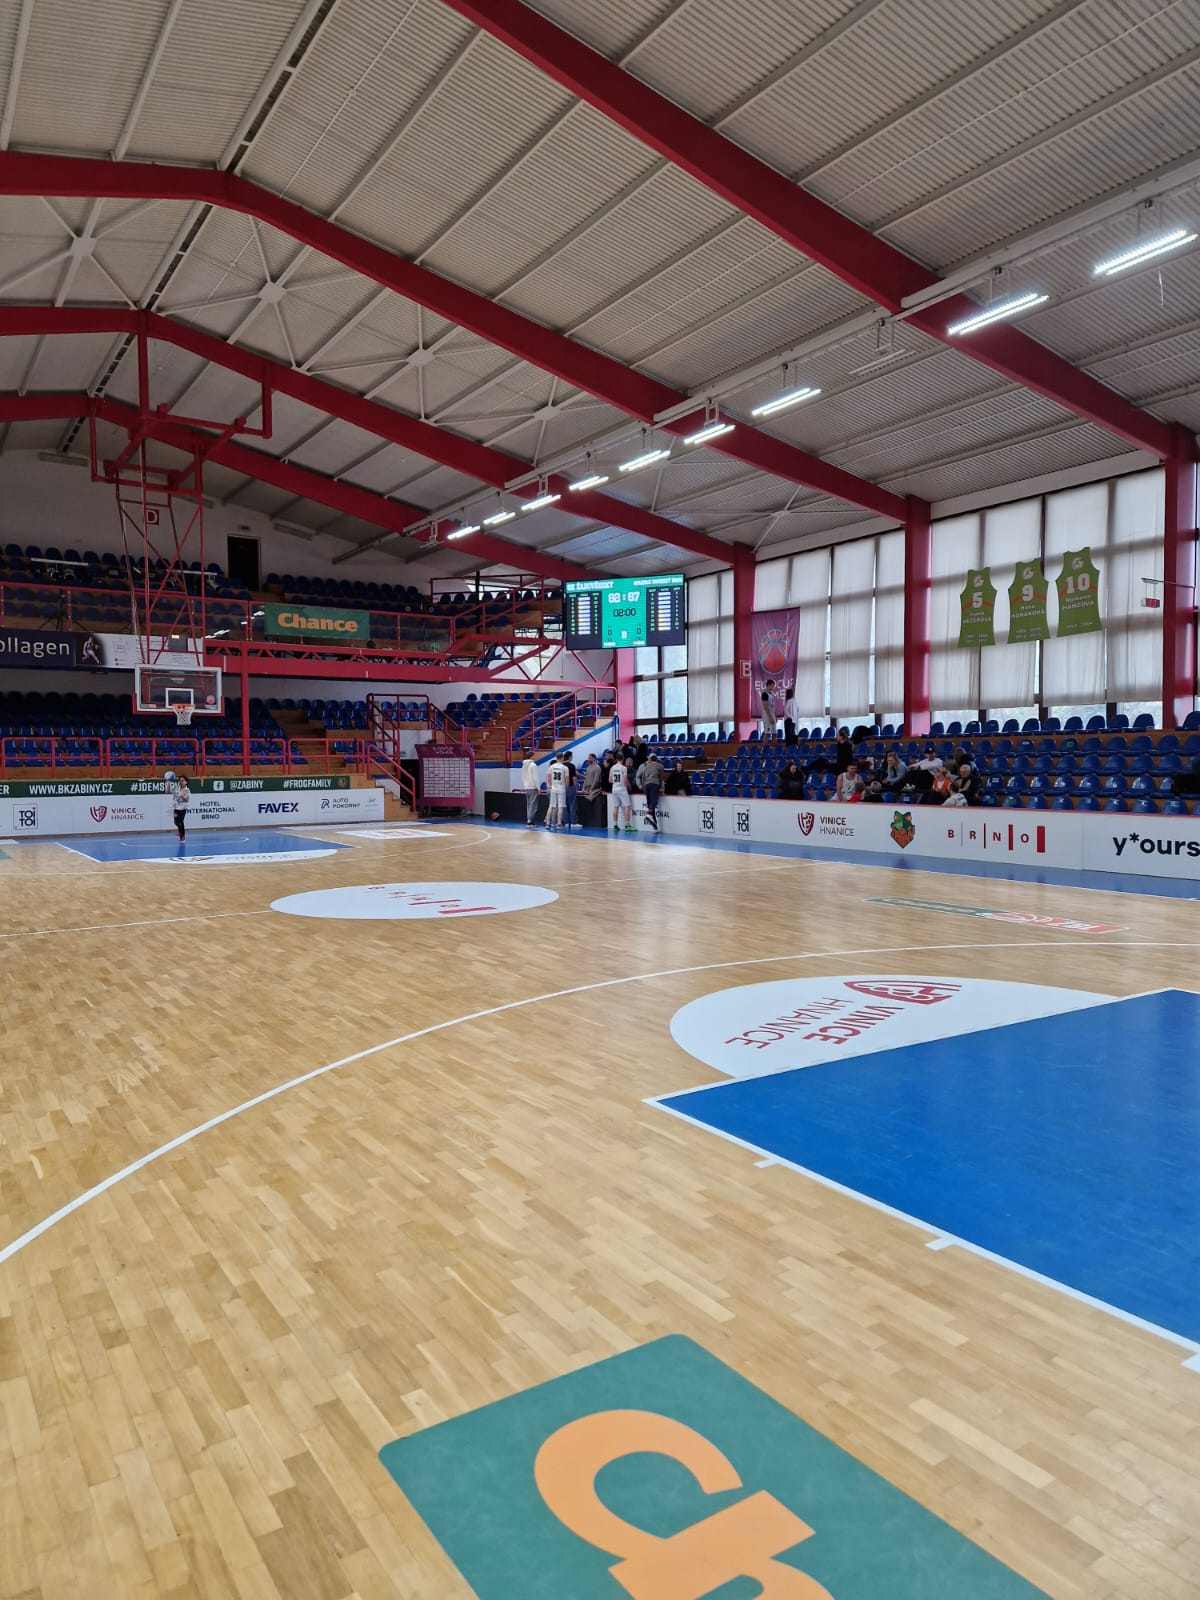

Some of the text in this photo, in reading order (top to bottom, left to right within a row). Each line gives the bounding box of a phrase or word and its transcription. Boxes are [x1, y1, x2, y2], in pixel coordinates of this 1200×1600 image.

[1066, 573, 1090, 594] 10
[973, 592, 983, 608] 5
[1022, 584, 1034, 601] 9
[277, 612, 358, 632] Chance
[742, 662, 751, 677] B
[29, 783, 113, 795] WWW.BKZABINY.CZ
[230, 780, 264, 791] @ZABINY
[283, 778, 332, 789] #FROGFAMILY
[258, 802, 299, 814] FAVEX
[111, 813, 144, 821] HNANICE
[820, 816, 847, 826] VINICE
[820, 827, 855, 837] HNANICE
[725, 997, 854, 1049] HNANICE
[802, 1005, 905, 1045] VINICE
